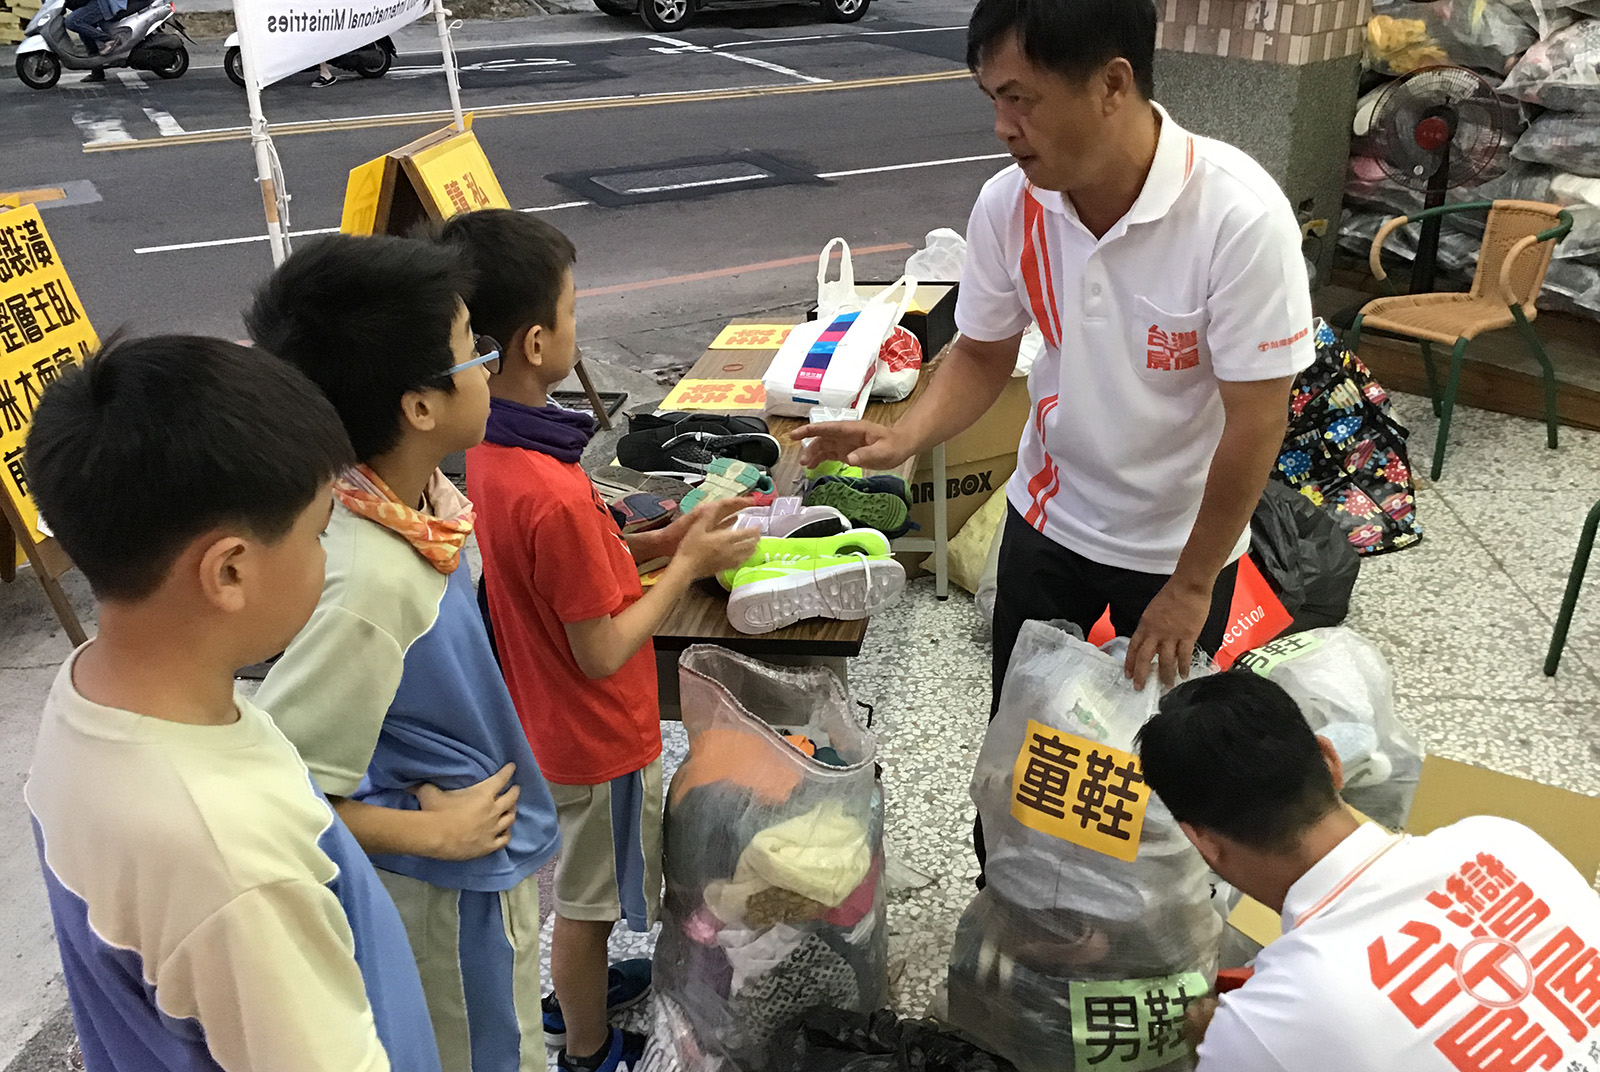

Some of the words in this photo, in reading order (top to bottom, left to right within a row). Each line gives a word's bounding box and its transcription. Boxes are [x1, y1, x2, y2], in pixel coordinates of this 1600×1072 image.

[0, 219, 54, 283] 裝潢
[946, 470, 993, 500] BOX
[1218, 605, 1265, 651] ection
[1016, 732, 1145, 841] 童鞋
[1084, 986, 1197, 1065] 男鞋
